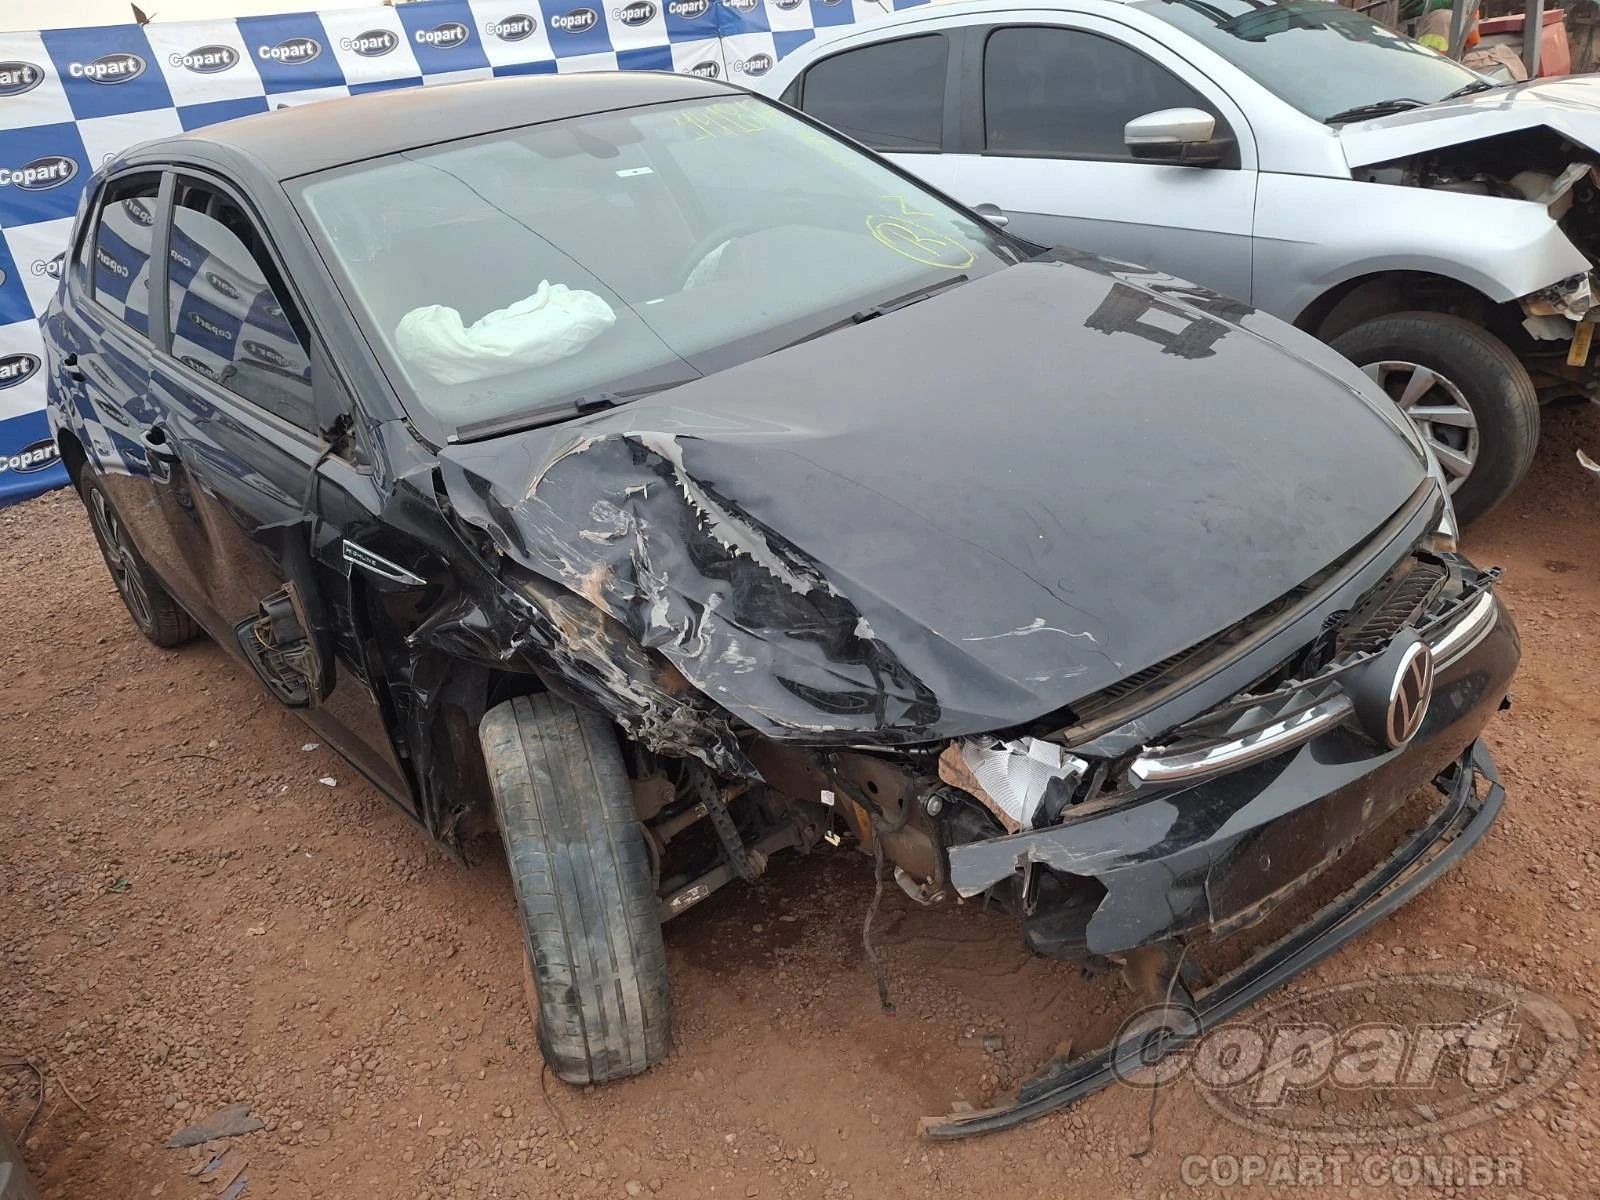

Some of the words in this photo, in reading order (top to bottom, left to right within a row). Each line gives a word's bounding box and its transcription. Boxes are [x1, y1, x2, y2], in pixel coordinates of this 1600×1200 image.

[612, 5, 651, 22] Copart
[668, 0, 704, 15] Copart
[486, 18, 530, 36] Copart
[551, 12, 593, 30] Copart
[340, 32, 391, 52] Copart
[415, 26, 463, 43] Copart
[169, 50, 230, 69] Copart
[258, 41, 313, 61] Copart
[0, 65, 33, 84] art
[69, 57, 136, 79] Copart
[734, 57, 768, 73] Copart
[0, 160, 67, 186] Copart
[0, 357, 29, 378] art
[345, 547, 378, 567] HIGHLINE
